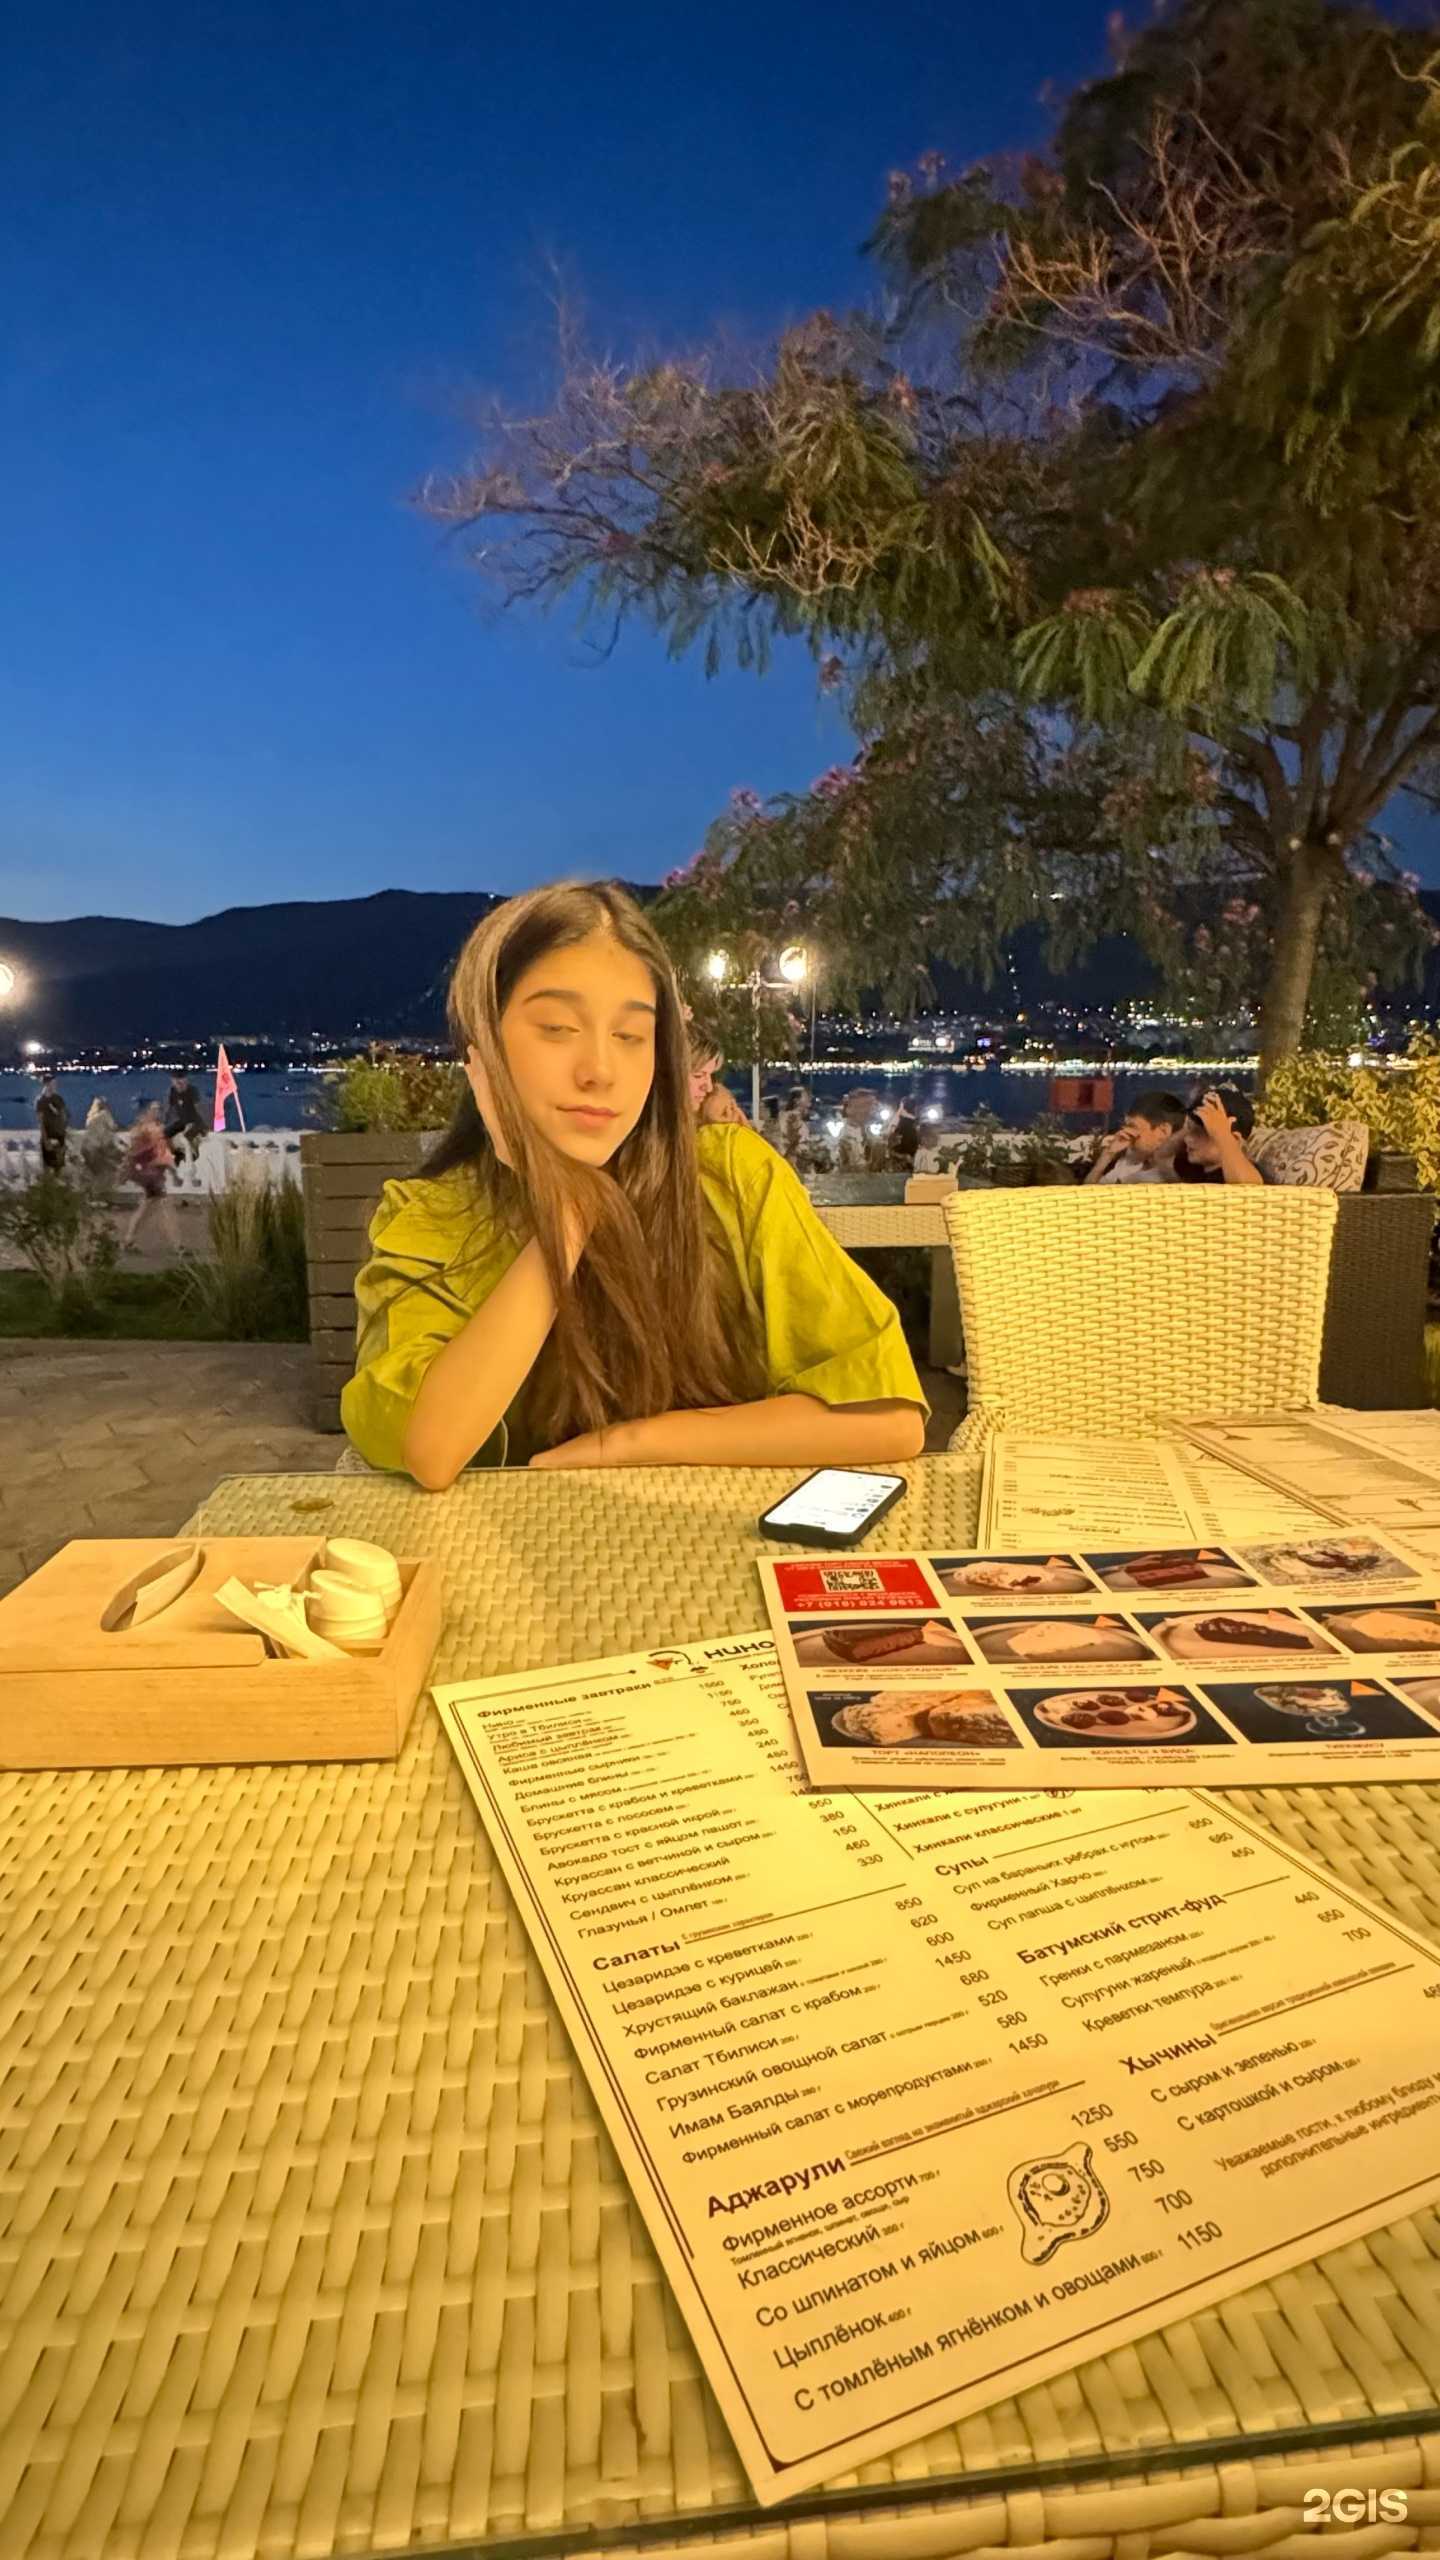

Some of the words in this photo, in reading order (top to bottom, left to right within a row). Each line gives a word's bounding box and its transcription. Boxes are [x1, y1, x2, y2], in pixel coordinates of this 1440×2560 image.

[477, 1696, 576, 1717] Фирменные
[581, 1682, 651, 1700] завтраки
[503, 1762, 538, 1775] Каша
[542, 1752, 592, 1766] овсяная
[508, 1766, 585, 1787] Фирменные
[589, 1755, 640, 1770] сырники
[514, 1779, 584, 1801] Домашние
[588, 1771, 629, 1783] блины
[520, 1800, 565, 1814] Блины
[580, 1787, 622, 1800] мясом
[527, 1806, 595, 1828] Брускетта
[609, 1794, 656, 1810] крабом
[671, 1775, 743, 1796] креветками
[875, 1794, 931, 1812] Хинкали
[533, 1821, 601, 1842] Брускетта
[618, 1805, 674, 1822] лососем
[539, 1834, 610, 1856] Брускетта
[626, 1819, 679, 1837] красной
[682, 1809, 721, 1825] икрой
[820, 1811, 845, 1823] 380
[893, 1813, 951, 1833] Хинкали
[964, 1797, 1020, 1815] сулугуни
[913, 1833, 973, 1854] Хинкали
[975, 1811, 1062, 1839] классические
[547, 1852, 608, 1871] Авокадо
[611, 1844, 640, 1857] тост
[656, 1830, 699, 1847] яйцом
[702, 1821, 742, 1836] пашот
[554, 1866, 622, 1887] Круассан
[638, 1847, 701, 1868] ветчиной
[716, 1832, 760, 1850] сыром
[857, 1854, 883, 1867] 330
[935, 1856, 989, 1876] Супы
[562, 1882, 631, 1904] Круассан
[634, 1856, 730, 1887] классический
[953, 1883, 981, 1895] Суп
[983, 1876, 1000, 1886] на
[1001, 1859, 1061, 1880] бараньих
[1109, 1844, 1119, 1852] с
[570, 1899, 636, 1921] Сендвич
[652, 1874, 733, 1902] цыплёнком
[895, 1897, 923, 1911] 850
[971, 1882, 1050, 1912] Фирменный
[1052, 1872, 1092, 1888] Харчо
[578, 1915, 648, 1940] Глазунья
[660, 1899, 709, 1918] Омлет
[910, 1914, 938, 1928] 620
[988, 1915, 1017, 1931] Суп
[1019, 1901, 1064, 1922] лапша
[1065, 1899, 1075, 1907] с
[1017, 1921, 1127, 1965] Батумский
[1128, 1894, 1227, 1929] стрит-фуд
[1318, 1909, 1345, 1923] 650
[1342, 1927, 1372, 1942] 700
[593, 1940, 681, 1971] Салаты
[602, 1962, 690, 1994] Цезаридзе
[694, 1959, 704, 1969] с
[707, 1934, 795, 1967] креветками
[936, 1950, 972, 1968] 1450
[1040, 1964, 1093, 1988] Гренки
[1093, 1960, 1104, 1970] с
[1104, 1933, 1188, 1966] пармезаном
[612, 1983, 701, 2016] Цезаридзе
[706, 1979, 717, 1989] с
[720, 1960, 783, 1986] курицей
[960, 1969, 989, 1986] 680
[978, 1990, 1008, 2007] 520
[1061, 1980, 1130, 2009] Сулугуни
[1131, 1957, 1196, 1985] жареный
[622, 2002, 718, 2038] Хрустящий
[720, 1979, 799, 2009] баклажан
[634, 2021, 736, 2059] Фирменный
[740, 2008, 787, 2029] салат
[791, 2003, 801, 2013] с
[804, 1987, 862, 2010] крабом
[997, 2011, 1028, 2029] 580
[1082, 2002, 1154, 2033] Креветки
[1153, 1980, 1214, 2008] темпура
[645, 2060, 701, 2085] Салат
[704, 2036, 779, 2067] Тбилиси
[1009, 2033, 1049, 2054] 1450
[1119, 2033, 1217, 2075] Хычины
[656, 2070, 758, 2113] Грузинский
[761, 2045, 838, 2079] овощной
[841, 2031, 888, 2053] салат
[1151, 2088, 1167, 2103] С
[1169, 2071, 1222, 2097] сыром
[1224, 2065, 1236, 2078] и
[1234, 2042, 1299, 2073] зеленью
[669, 2113, 725, 2139] Имам
[727, 2088, 800, 2120] Баялды
[682, 2123, 783, 2165] Фирменный
[786, 2107, 831, 2130] салат
[834, 2102, 845, 2114] с
[848, 2061, 973, 2111] морепродуктами
[1071, 2103, 1114, 2128] 1250
[1176, 2115, 1195, 2131] С
[1195, 2083, 1281, 2126] картошкой
[1280, 2080, 1290, 2093] и
[1293, 2060, 1343, 2089] сыром
[1104, 2130, 1139, 2153] 550
[1214, 2133, 1297, 2172] Уважаемые
[1334, 2113, 1346, 2123] к
[1390, 2077, 1435, 2098] блюду
[1128, 2159, 1166, 2183] 750
[1260, 2125, 1370, 2180] дополнительные
[708, 2157, 847, 2219] Аджарули
[1155, 2189, 1194, 2215] 700
[722, 2202, 838, 2252] Фирменное
[842, 2173, 918, 2210] ассорти
[737, 2224, 881, 2290] Классический
[1177, 2221, 1223, 2251] 1150
[756, 2305, 788, 2327] Со
[792, 2263, 898, 2314] шпинатом
[900, 2255, 916, 2270] и
[918, 2229, 982, 2265] яйцом
[773, 2312, 888, 2369] Цыплёнок
[794, 2388, 815, 2411] С
[818, 2341, 934, 2401] томлёным
[937, 2299, 1033, 2352] ягнёнком
[1033, 2292, 1050, 2309] и
[1051, 2254, 1142, 2301] овощами
